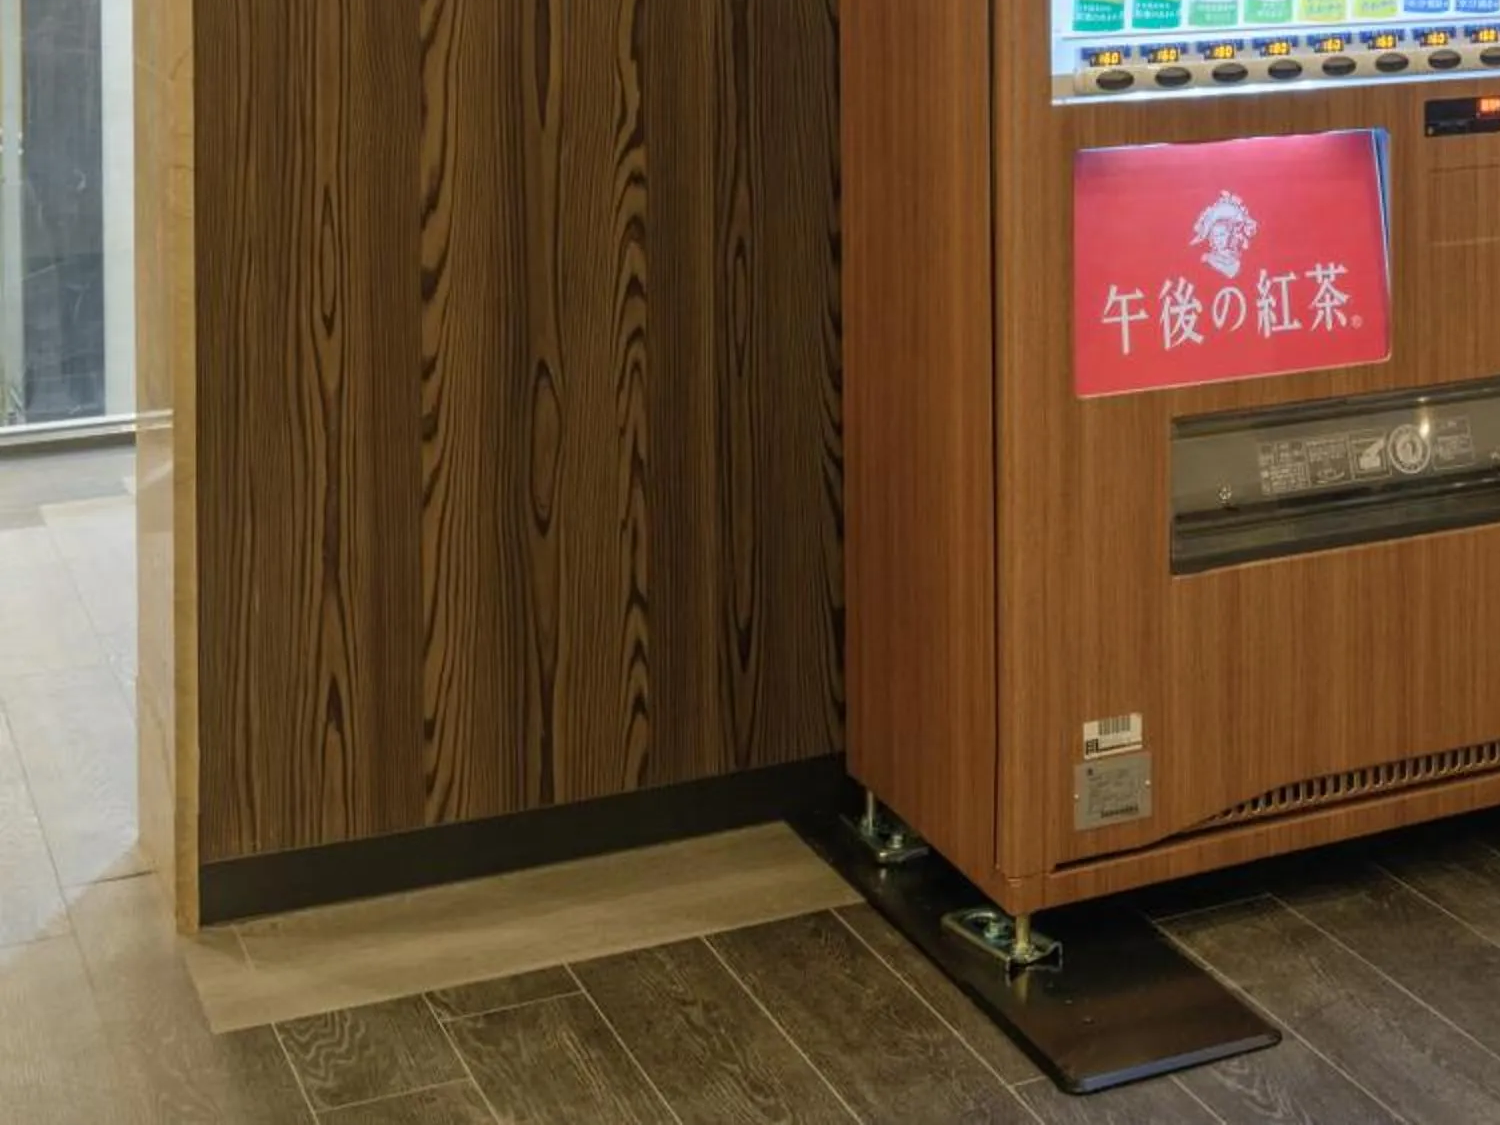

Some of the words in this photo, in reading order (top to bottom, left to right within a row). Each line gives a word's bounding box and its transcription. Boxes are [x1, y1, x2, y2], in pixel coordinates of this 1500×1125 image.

[1101, 262, 1350, 356] 午後の紅茶
